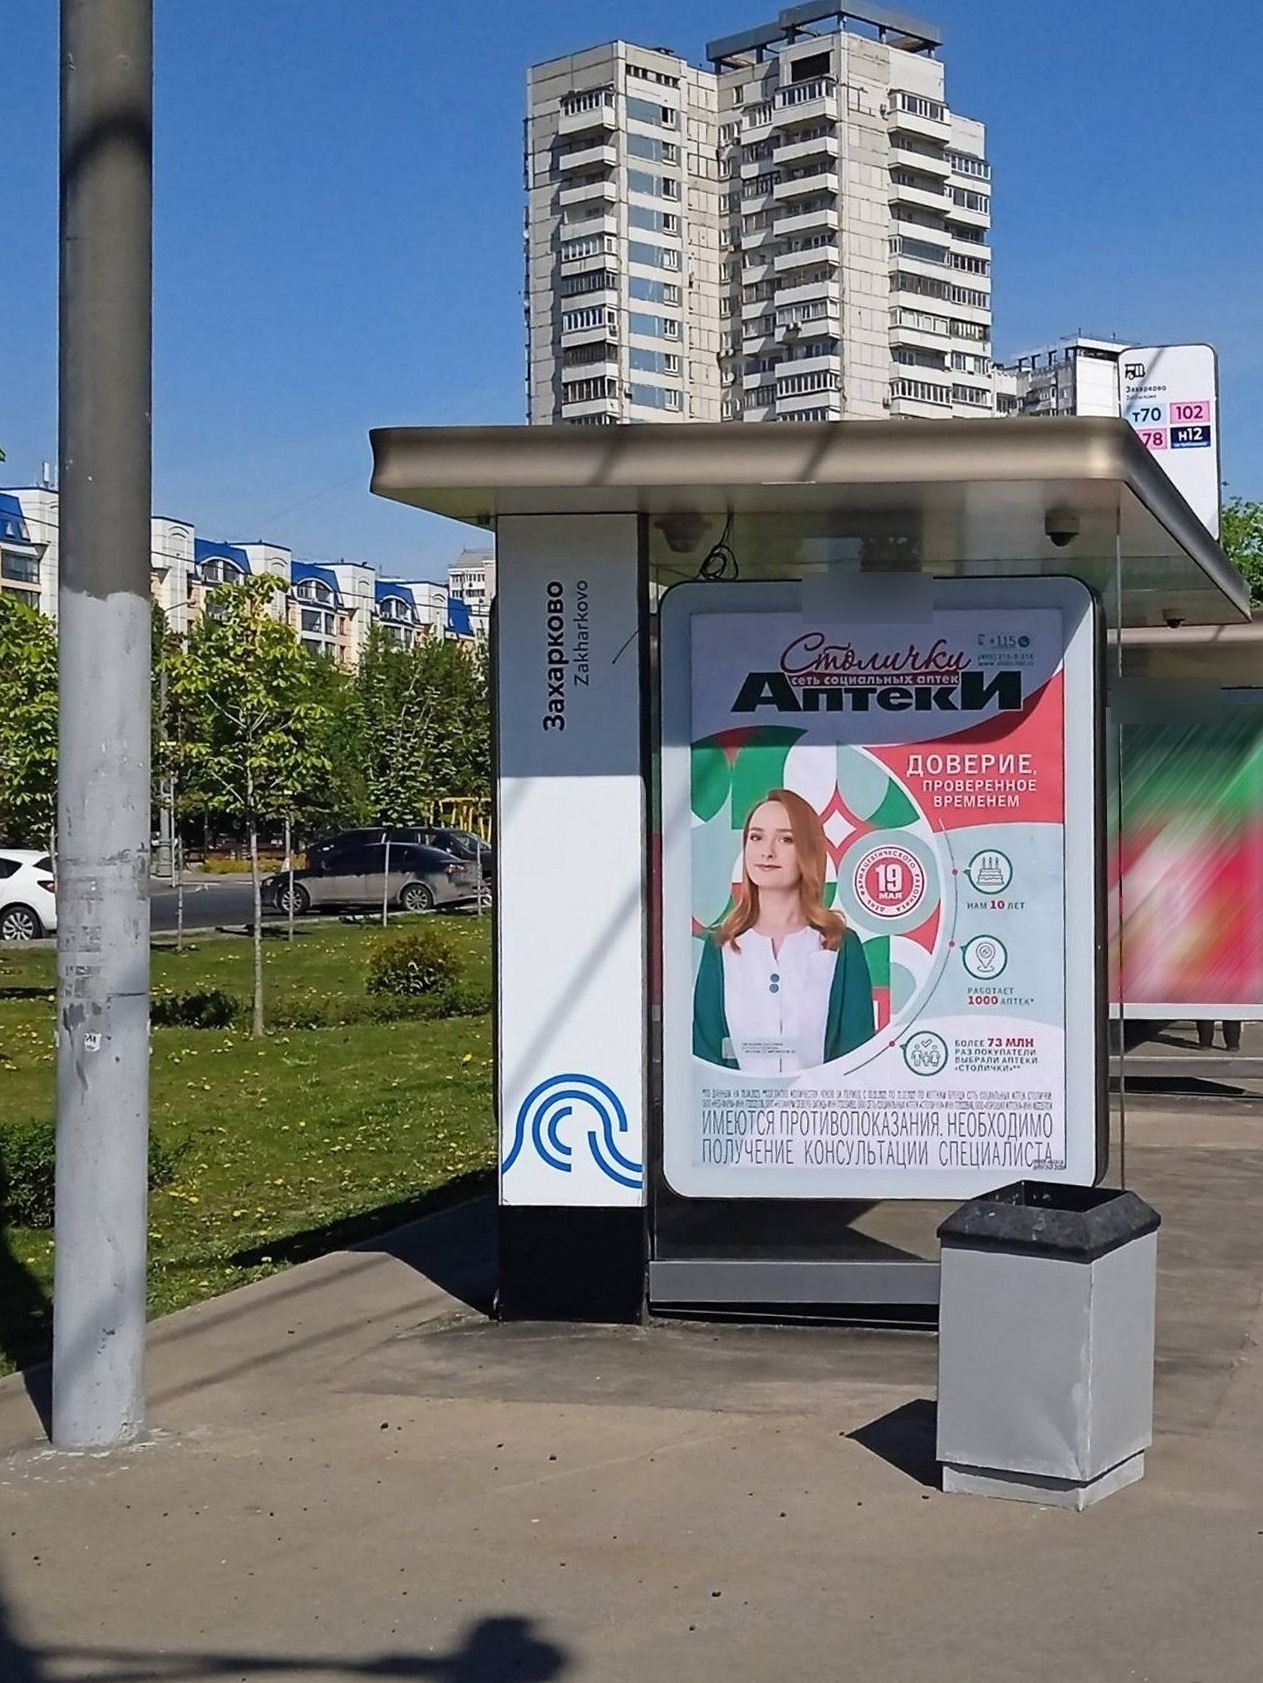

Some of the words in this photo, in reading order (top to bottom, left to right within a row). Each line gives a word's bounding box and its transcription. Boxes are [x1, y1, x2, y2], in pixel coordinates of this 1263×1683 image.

[1176, 405, 1203, 420] 102
[1142, 432, 1163, 446] 78
[573, 580, 589, 686] Zakharkovo
[543, 581, 569, 731] Захарково
[780, 632, 971, 674] Столички
[792, 676, 820, 686] сеть
[824, 675, 912, 687] социальных
[917, 674, 960, 684] аптек
[923, 779, 1037, 792] ПРОВЕРЕННОЕ
[934, 795, 1020, 808] ВРЕМЕНЕМ
[875, 864, 902, 891] 19
[990, 900, 1005, 909] 10
[967, 987, 1014, 995] РАБОТАЕТ
[968, 995, 998, 1005] 1000
[955, 1039, 984, 1047] БОЛЕЕ
[987, 1038, 1002, 1047] 73
[1005, 1038, 1034, 1047] МЛН
[702, 1110, 775, 1136] ИМЕЮТСЯ
[780, 1110, 943, 1137] ПРОТИВОПОКАЗАНИЯ.
[947, 1112, 1053, 1141] НЕОБХОДИМО
[702, 1138, 794, 1164] ПОЛУЧЕНИЕ
[804, 1139, 928, 1169] КОНСУЛЬТАЦИИ
[939, 1141, 1053, 1169] СПЕЦИАЛИСТА
